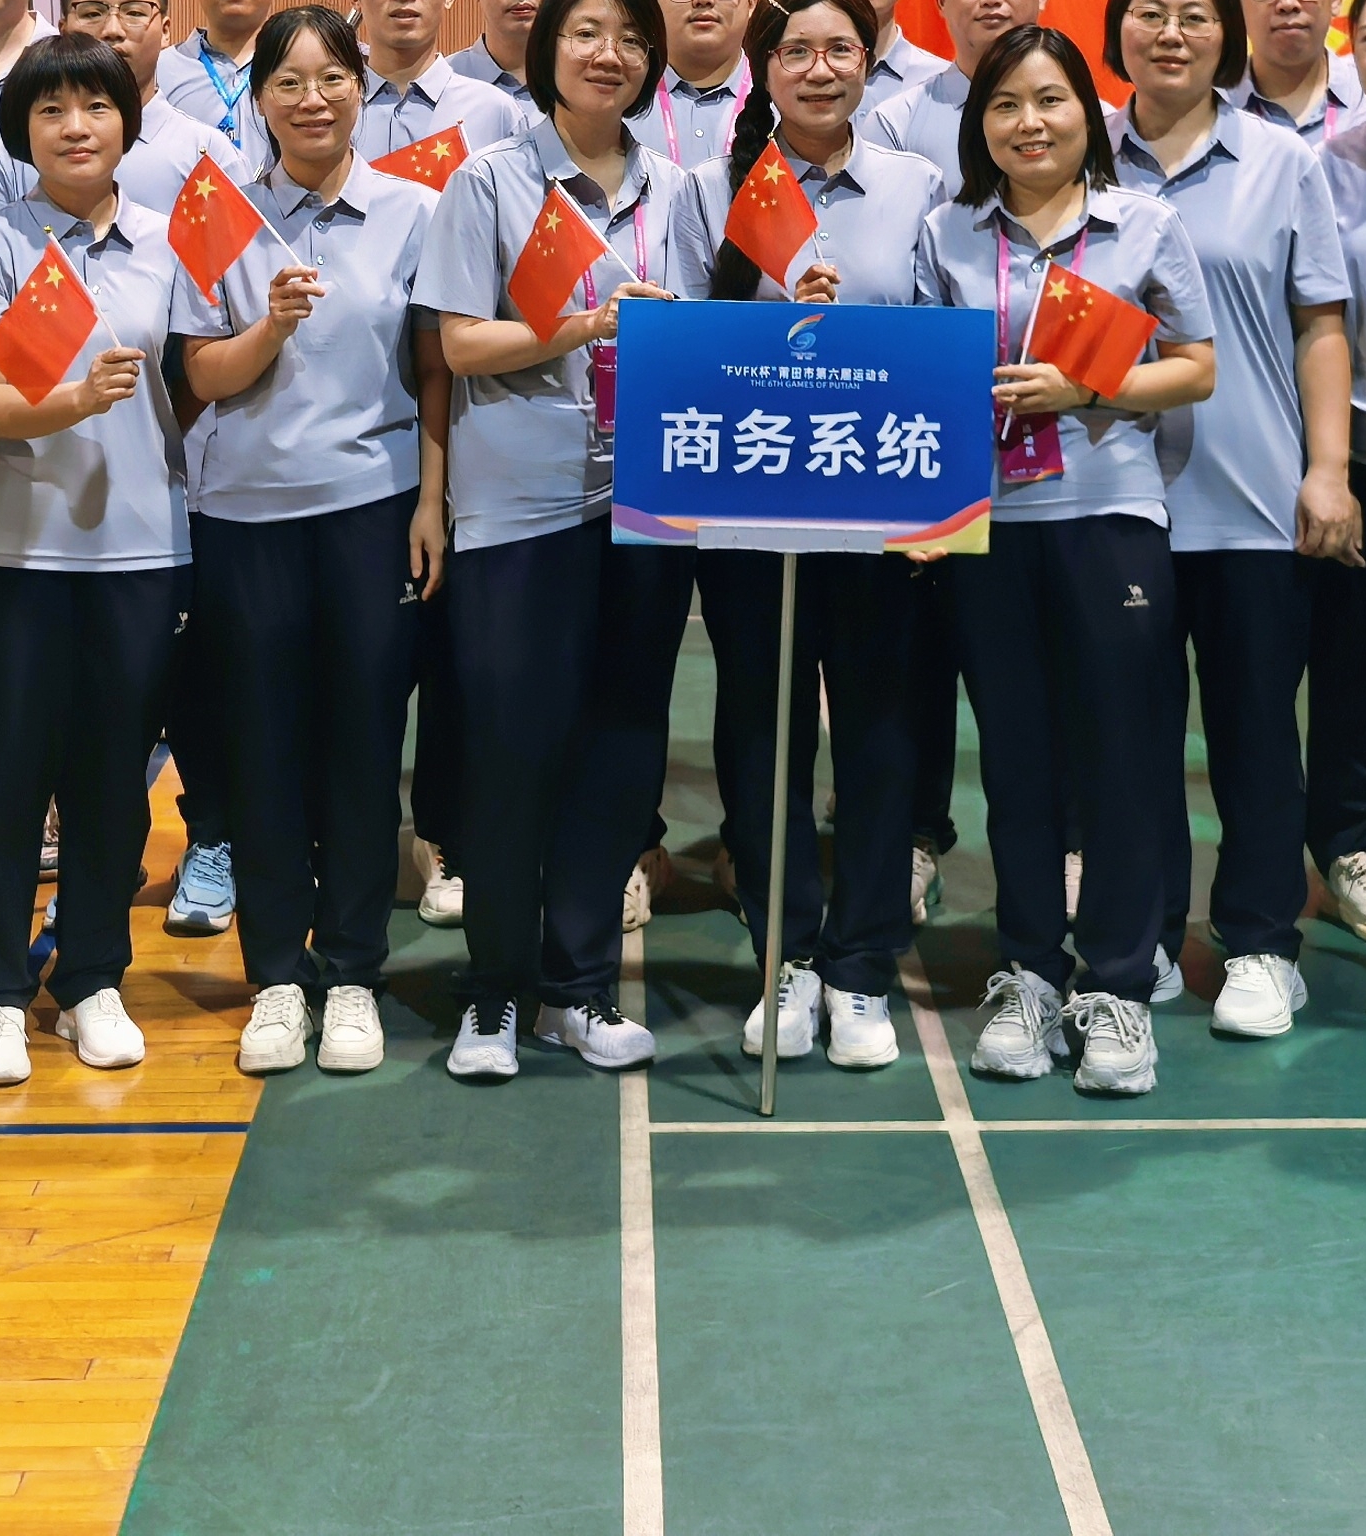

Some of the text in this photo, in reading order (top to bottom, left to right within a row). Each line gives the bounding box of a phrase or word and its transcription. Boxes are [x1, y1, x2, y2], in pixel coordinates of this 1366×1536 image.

[750, 379, 861, 390] THE 6TH GAMES OF PUTIAN
[660, 406, 942, 480] 商务系统
